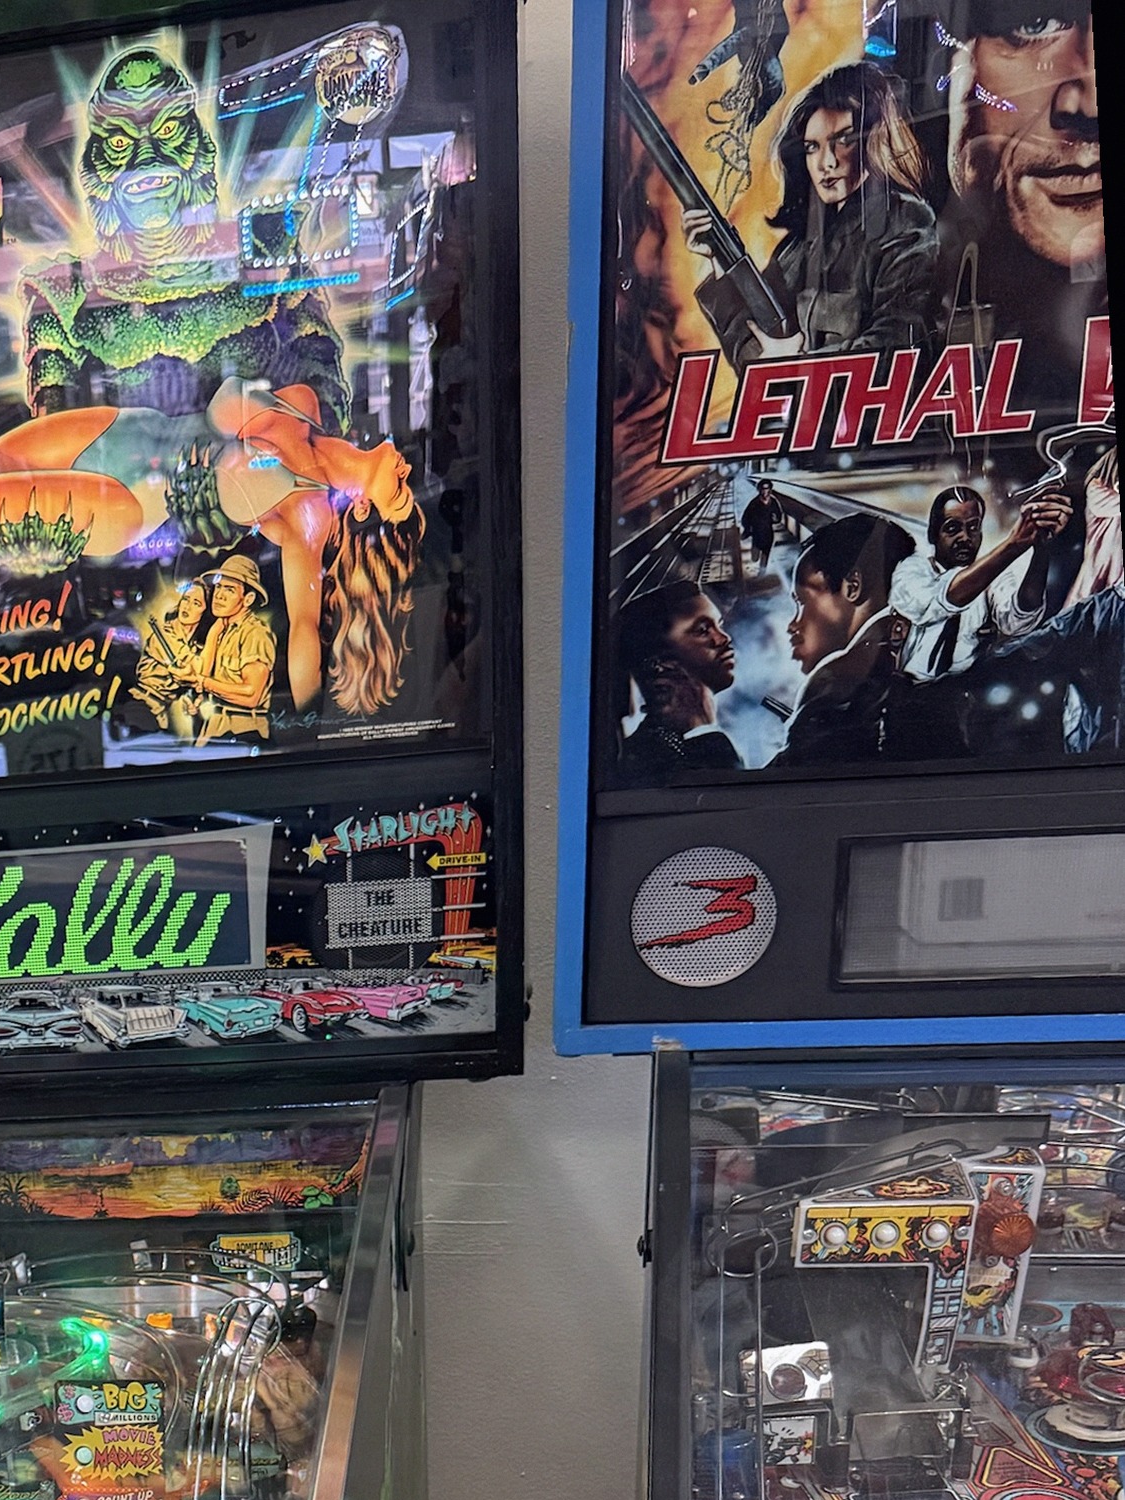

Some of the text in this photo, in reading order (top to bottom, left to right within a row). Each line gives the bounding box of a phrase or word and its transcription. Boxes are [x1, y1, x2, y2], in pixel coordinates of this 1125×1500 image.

[661, 338, 1036, 465] LETHAL
[332, 801, 475, 853] STARLIGHT
[439, 855, 482, 865] DRIVE-IN
[364, 889, 395, 906] THE
[103, 1382, 147, 1411] BIG
[102, 1428, 156, 1445] MOVIE
[94, 1446, 163, 1470] MADNESS
